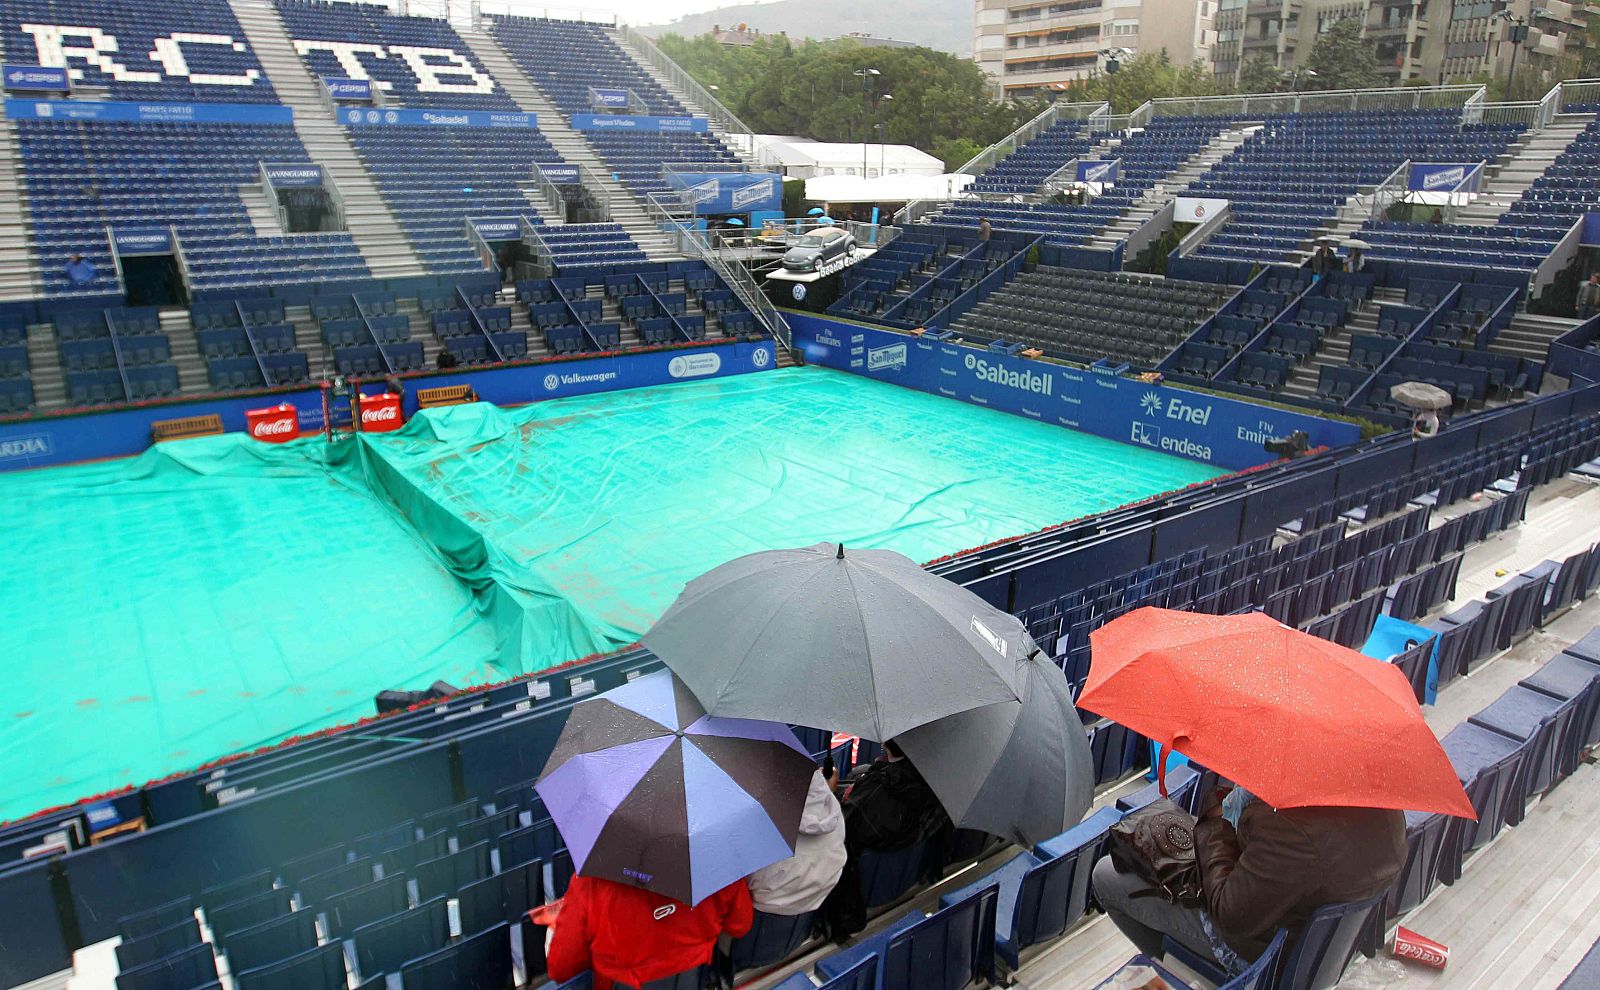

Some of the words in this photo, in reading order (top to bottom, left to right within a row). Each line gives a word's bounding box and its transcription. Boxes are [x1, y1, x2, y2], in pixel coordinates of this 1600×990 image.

[815, 333, 841, 347] Emirates
[560, 371, 617, 385] Volkswagen
[975, 358, 1054, 397] Sabadell
[1166, 397, 1212, 427] Enel
[1258, 420, 1274, 433] Fly
[0, 438, 48, 458] RDIA
[1160, 434, 1212, 461] endesa
